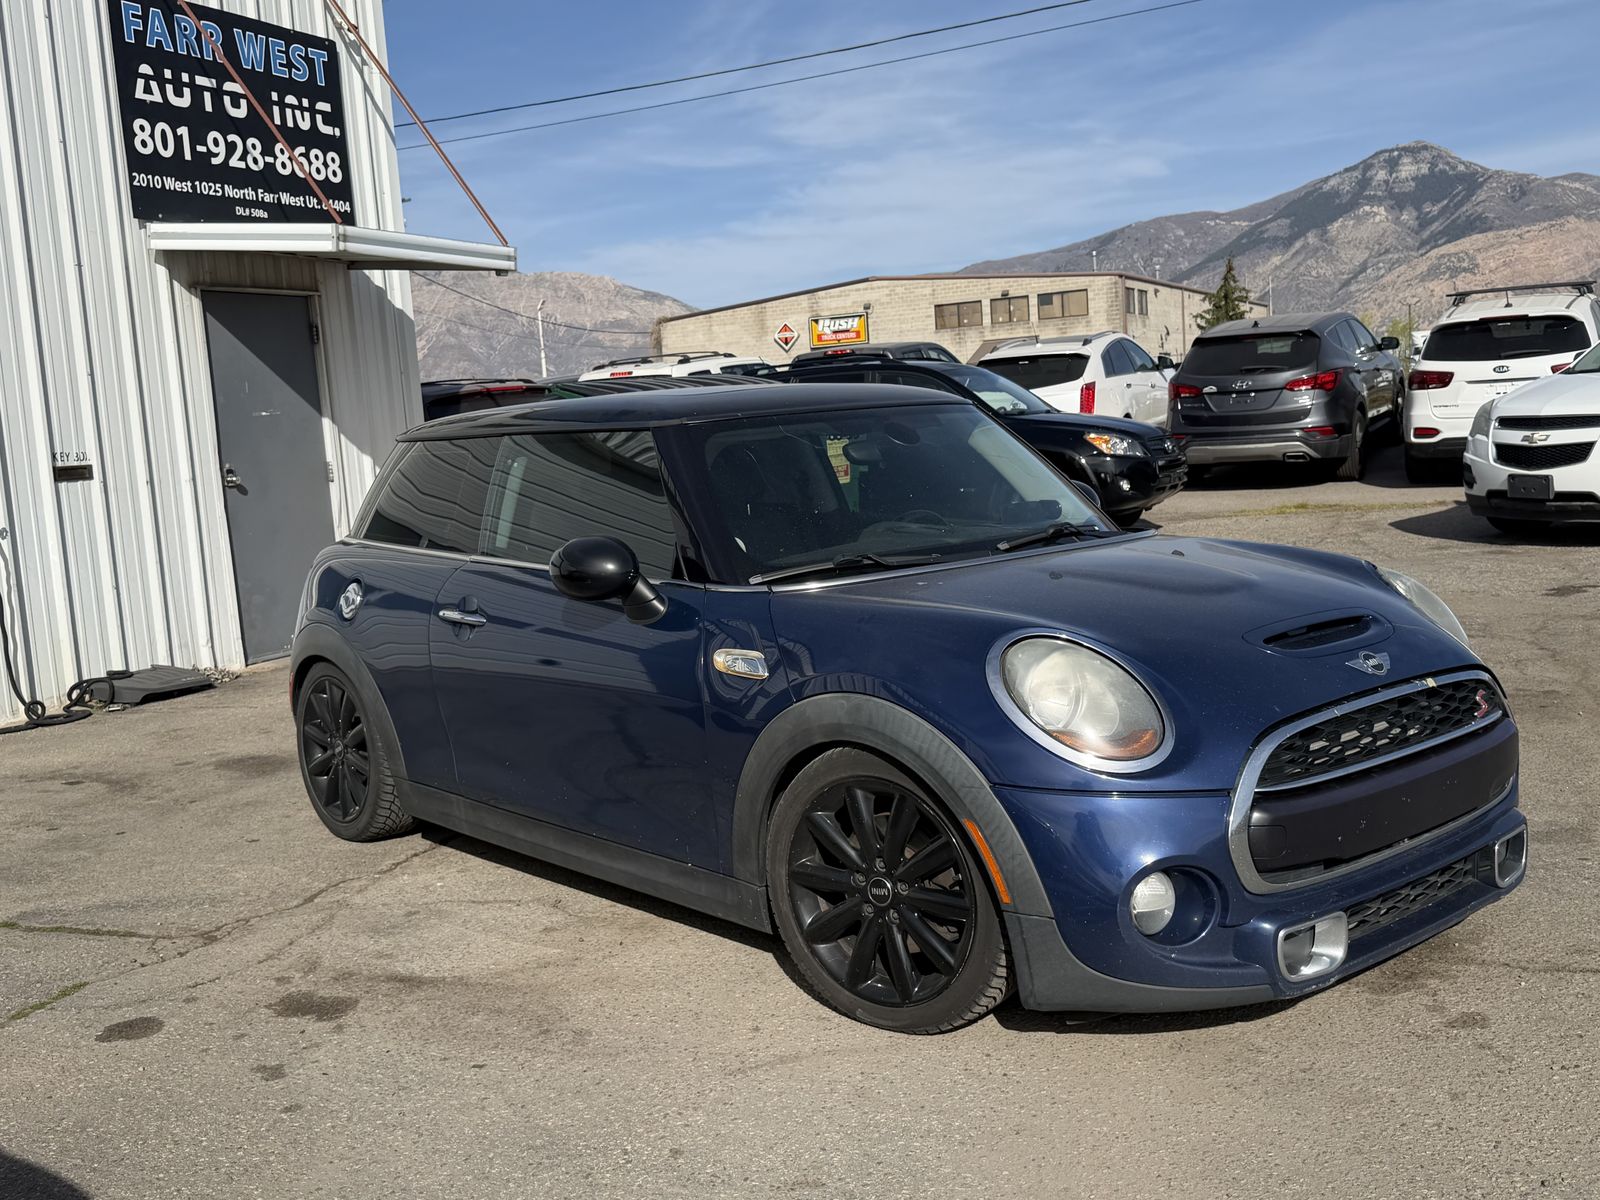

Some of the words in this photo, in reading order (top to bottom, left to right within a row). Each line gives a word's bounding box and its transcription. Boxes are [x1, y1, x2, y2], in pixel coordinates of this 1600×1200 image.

[121, 0, 223, 63] FARR
[233, 28, 328, 86] WEST
[134, 63, 248, 118] AUTO
[132, 118, 343, 183] 801-928-8688
[132, 172, 162, 189] 2010
[163, 176, 193, 193] West
[195, 180, 223, 197] 1025
[225, 184, 256, 201] North
[258, 188, 279, 204] Farr
[281, 192, 305, 207] West
[305, 195, 321, 209] Ut.
[236, 206, 250, 217] DL#
[818, 317, 859, 334] RUSH
[53, 451, 71, 462] KEY
